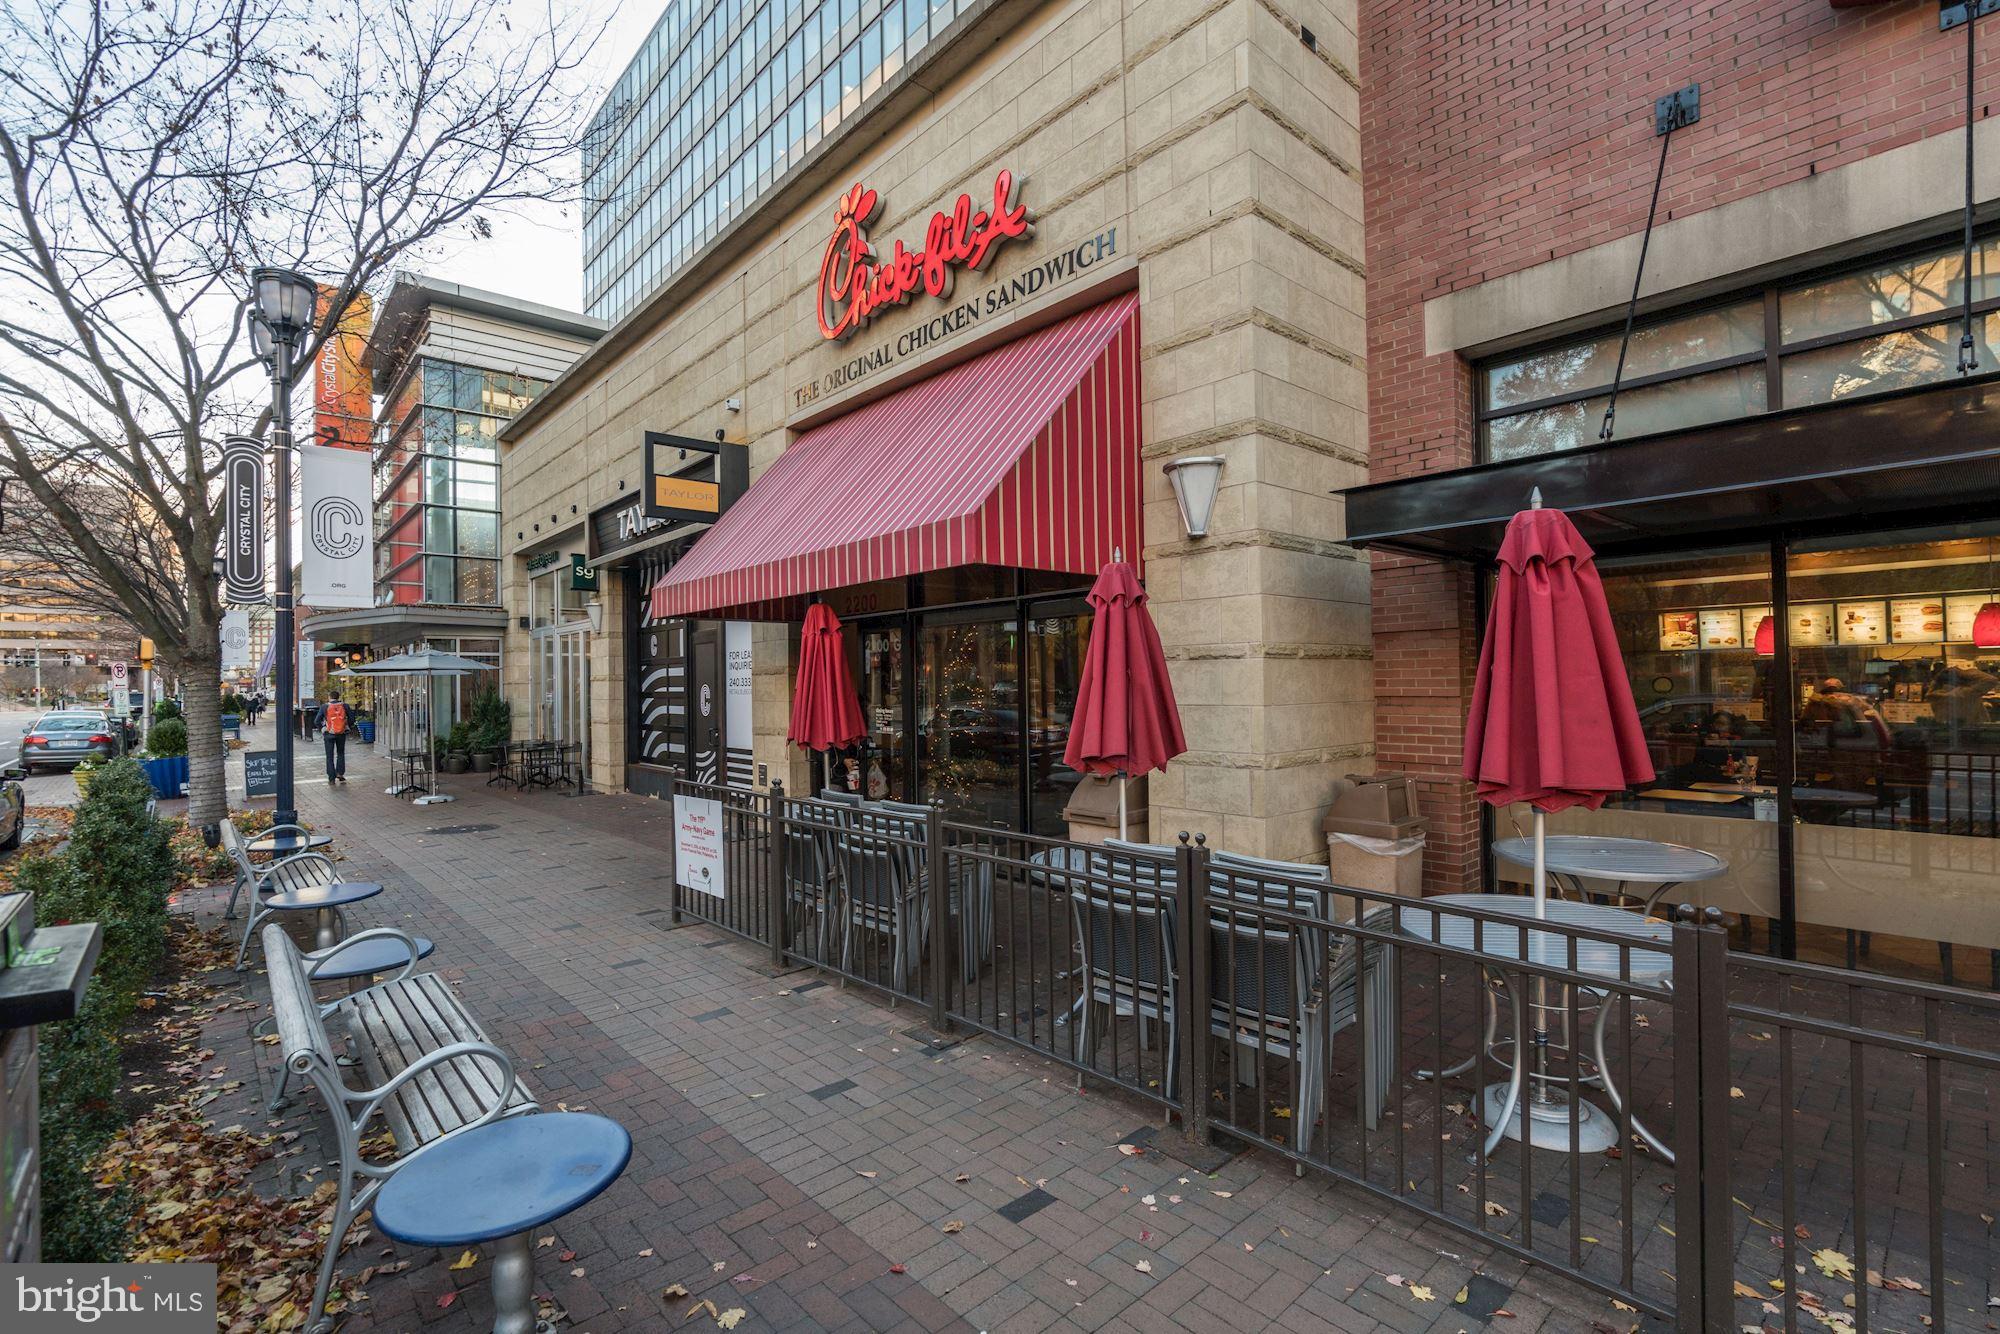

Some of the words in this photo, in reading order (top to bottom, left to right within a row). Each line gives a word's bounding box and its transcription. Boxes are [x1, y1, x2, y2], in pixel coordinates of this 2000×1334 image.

[817, 169, 1028, 340] Chick-fil-A
[793, 379, 820, 407] THE
[823, 343, 893, 393] ORIGINAL
[897, 298, 980, 356] CHICKEN
[986, 225, 1117, 314] SANDWICH
[239, 484, 251, 510] CITY
[661, 487, 714, 501] TAYLOR
[239, 511, 251, 556] CRYSTAL
[315, 533, 346, 556] CRYSTAL
[348, 536, 360, 552] CITY
[576, 566, 594, 579] sg
[846, 593, 877, 613] 2200
[729, 651, 740, 660] FOR
[741, 649, 752, 660] LEA
[689, 814, 697, 822] The
[682, 824, 703, 835] Army-Navy
[703, 827, 716, 836] Game
